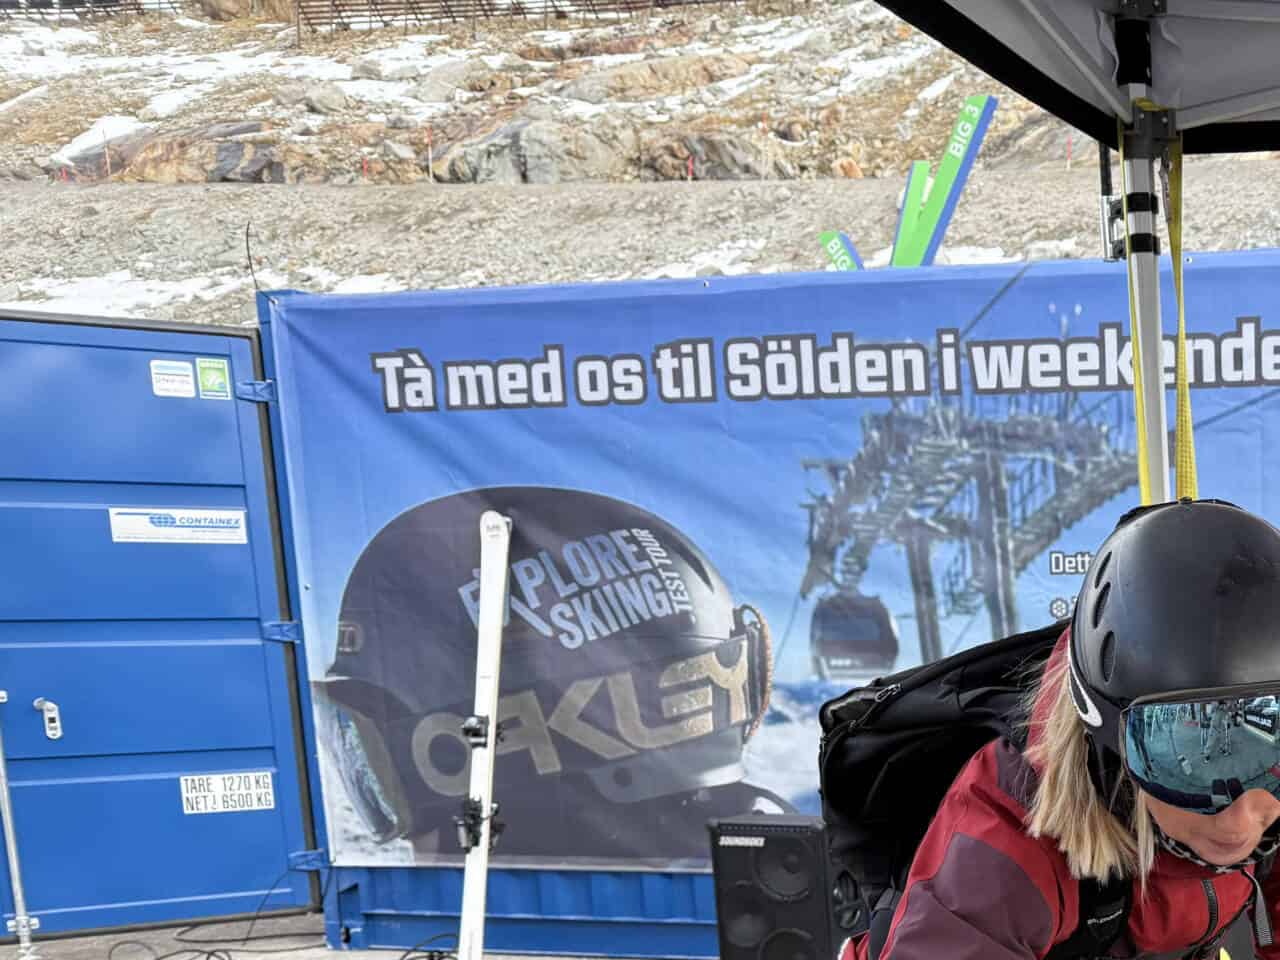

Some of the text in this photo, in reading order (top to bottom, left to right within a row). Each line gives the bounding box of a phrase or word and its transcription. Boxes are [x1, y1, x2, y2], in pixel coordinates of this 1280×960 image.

[950, 104, 980, 159] BIG 3
[445, 348, 566, 408] med
[575, 356, 645, 403] os
[653, 341, 715, 401] til
[726, 331, 929, 398] Sölden
[939, 331, 960, 392] i
[178, 515, 241, 526] CONTAINEX
[631, 528, 695, 614] TEST TOUR
[1050, 552, 1090, 574] Dett
[550, 571, 673, 649] SKIING
[411, 634, 749, 797] OAKLEY
[221, 775, 252, 791] 1270
[254, 774, 270, 790] KG
[221, 792, 254, 809] 6500
[256, 791, 272, 807] KG
